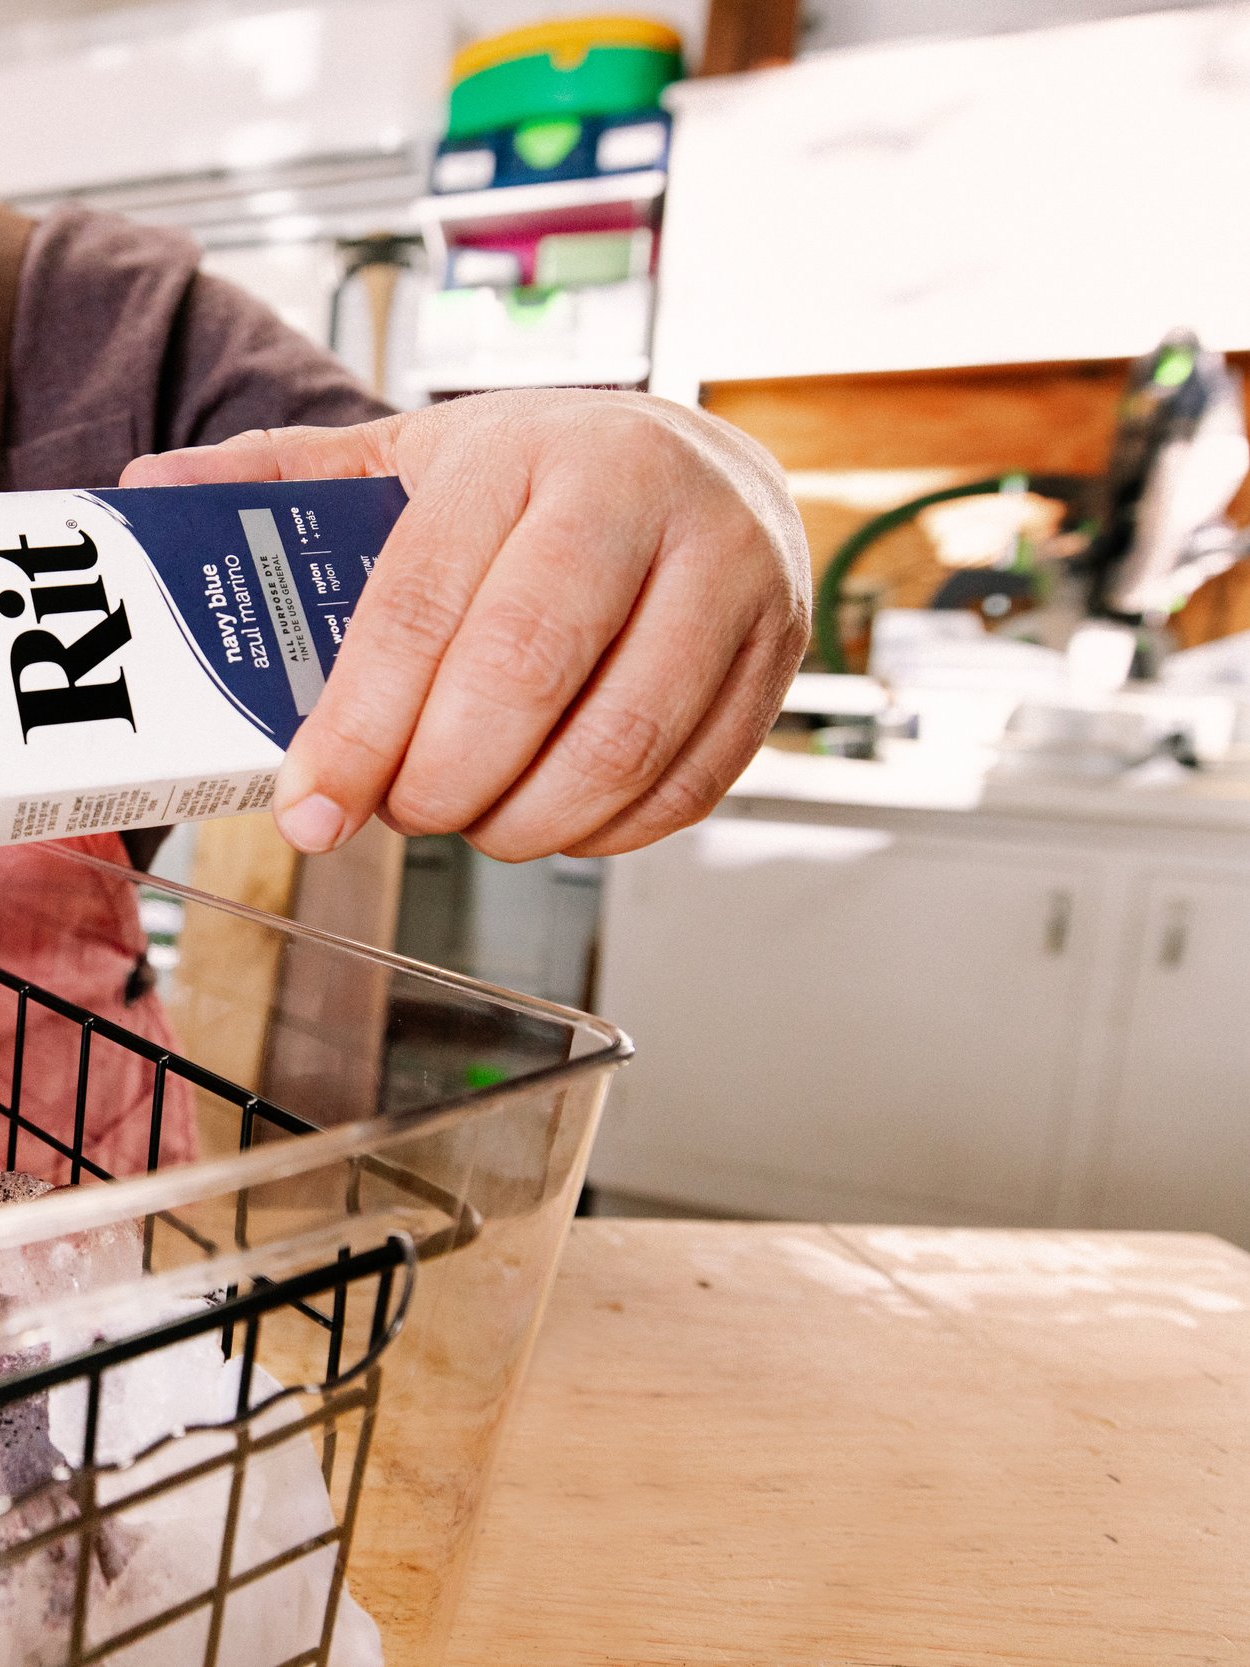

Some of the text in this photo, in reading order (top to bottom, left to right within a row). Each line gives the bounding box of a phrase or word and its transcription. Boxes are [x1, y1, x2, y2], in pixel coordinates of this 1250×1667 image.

[291, 507, 307, 535] more
[306, 510, 319, 530] más
[309, 563, 327, 594] nylon
[325, 563, 341, 591] nylon
[203, 564, 243, 664] navy blue
[225, 554, 270, 669] azul marino
[260, 555, 299, 662] ALL PURPOSE DYE
[272, 554, 310, 662] TINTE DE USO GENERAL
[324, 614, 343, 644] wool
